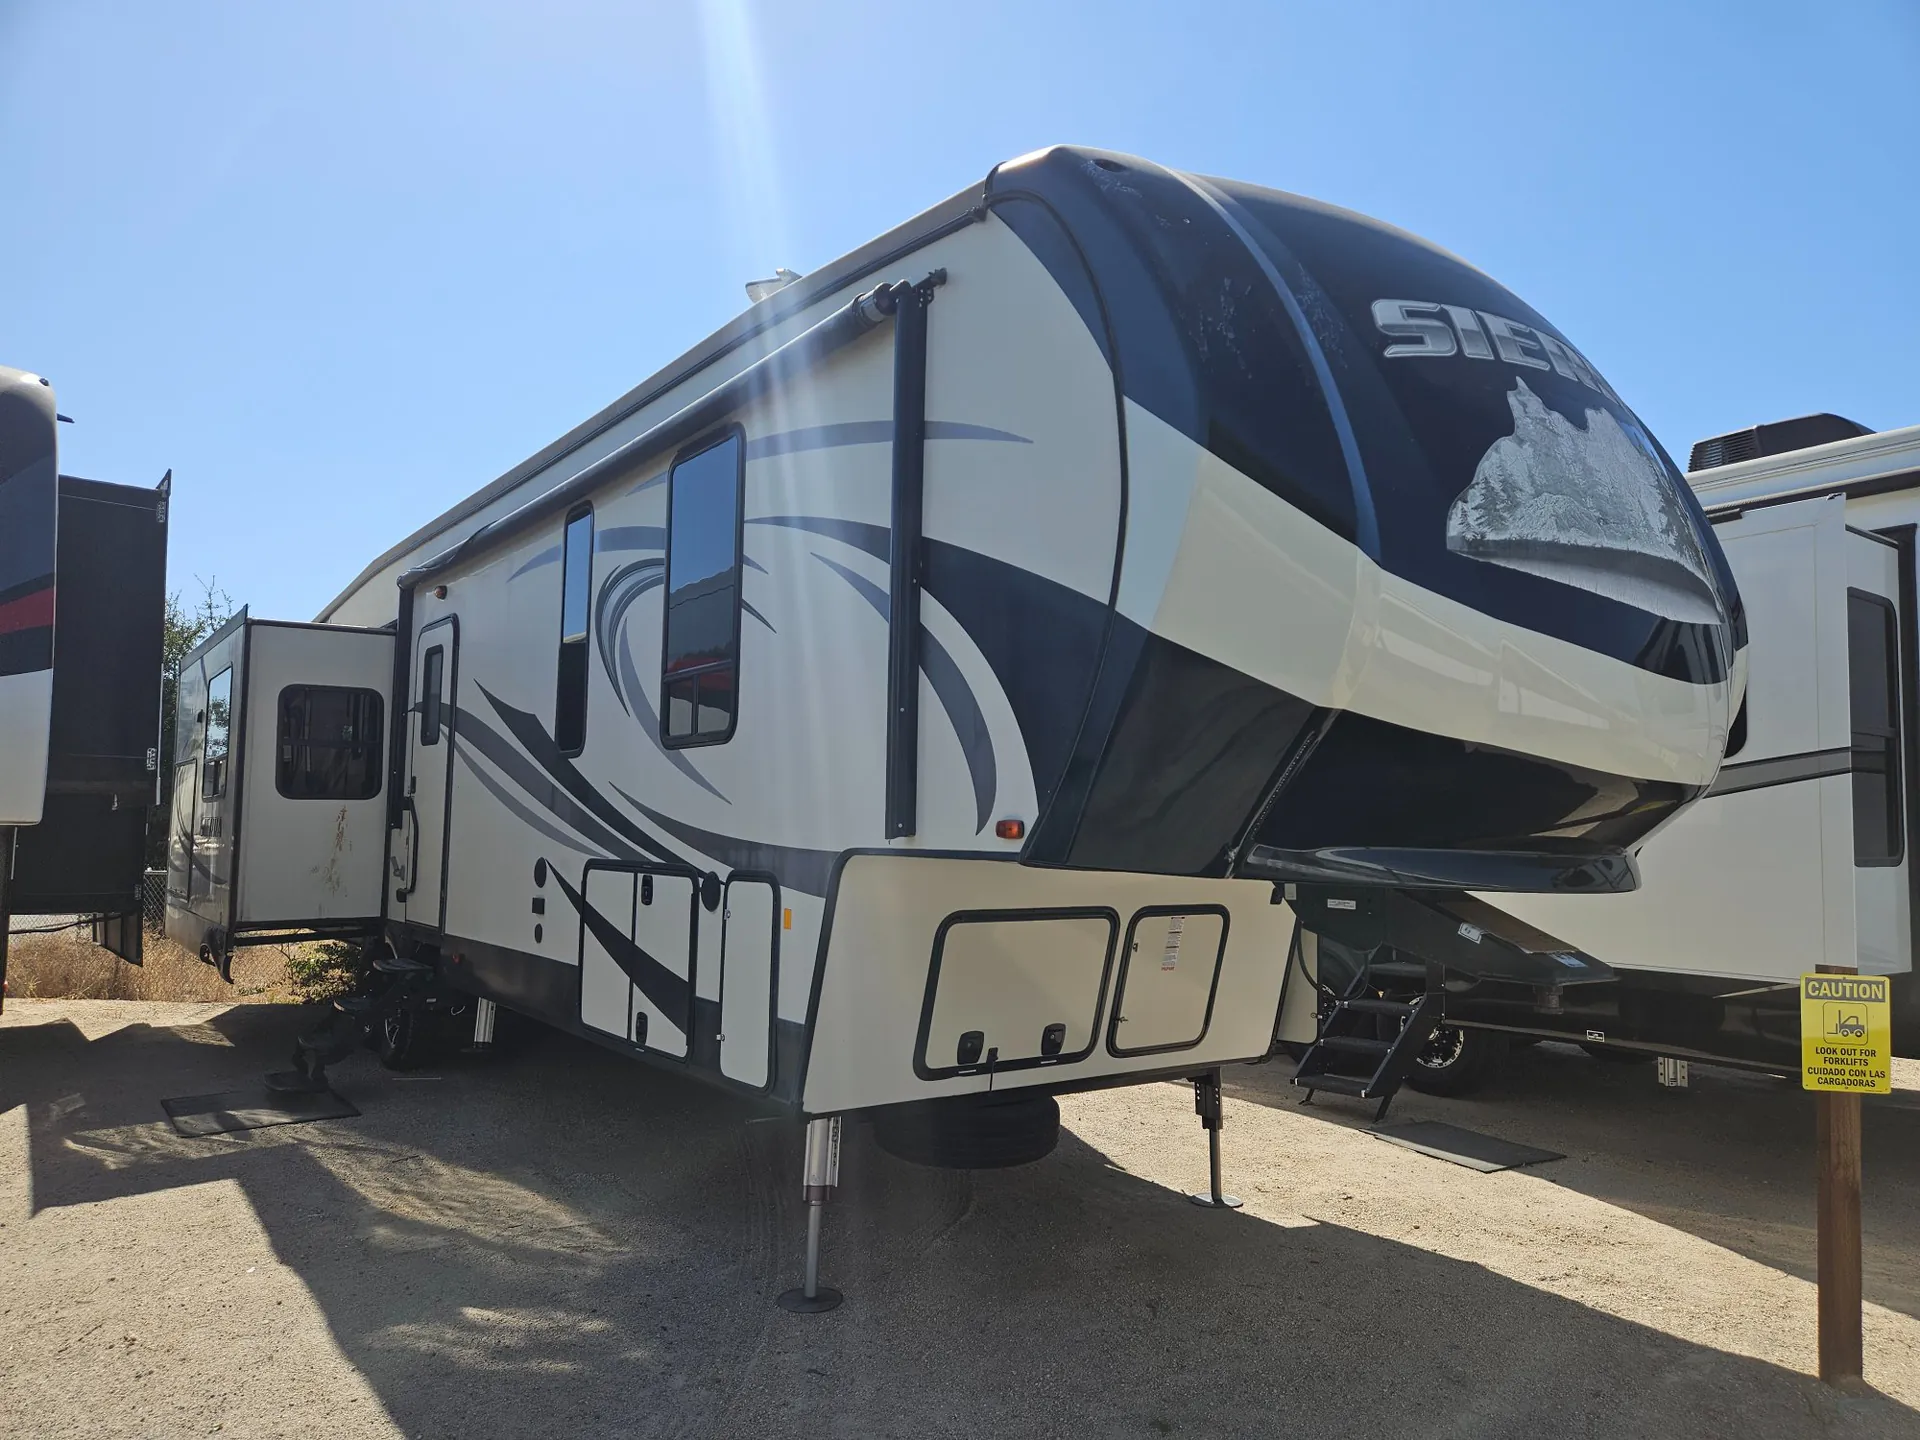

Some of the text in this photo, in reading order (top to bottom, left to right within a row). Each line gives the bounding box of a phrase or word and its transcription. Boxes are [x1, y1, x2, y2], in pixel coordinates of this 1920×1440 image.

[1807, 981, 1883, 999] CAUTION
[1815, 1047, 1877, 1057] LOOK OUT FOR
[1823, 1057, 1868, 1066] FORKLIFTS
[1807, 1067, 1886, 1078] CUIDADO CON LAS
[1817, 1077, 1876, 1087] CARGADORAS
